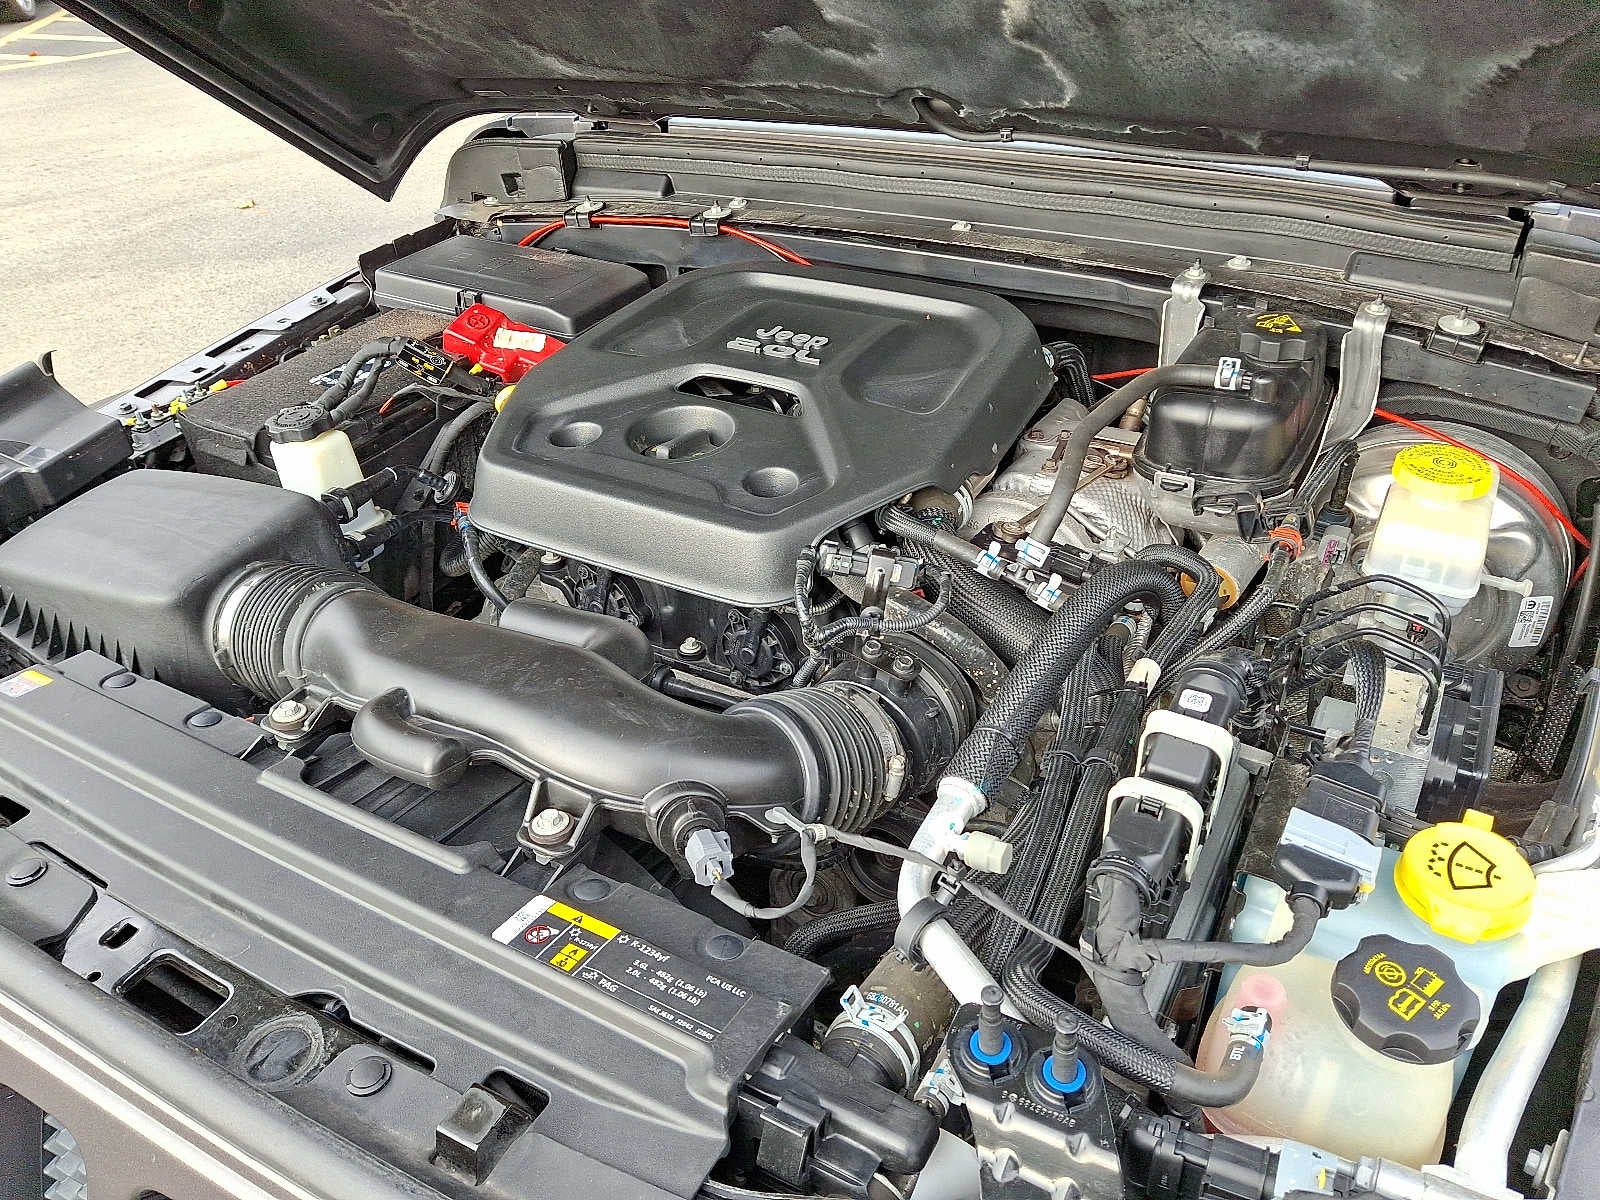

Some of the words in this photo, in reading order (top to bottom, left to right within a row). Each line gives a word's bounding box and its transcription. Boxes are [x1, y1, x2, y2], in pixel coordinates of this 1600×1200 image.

[755, 325, 829, 350] Jeep
[726, 336, 822, 366] 2.0L
[631, 940, 671, 962] R-1234yf
[597, 978, 619, 993] PAG
[625, 966, 641, 978] 2.0L
[648, 976, 668, 992] 482g
[667, 984, 688, 1001] (1.06
[632, 958, 648, 972] 3.6L
[655, 968, 675, 984] 482g
[674, 977, 696, 994] (1.06
[705, 974, 722, 986] FCA
[720, 980, 733, 992] US
[730, 985, 747, 998] LLC
